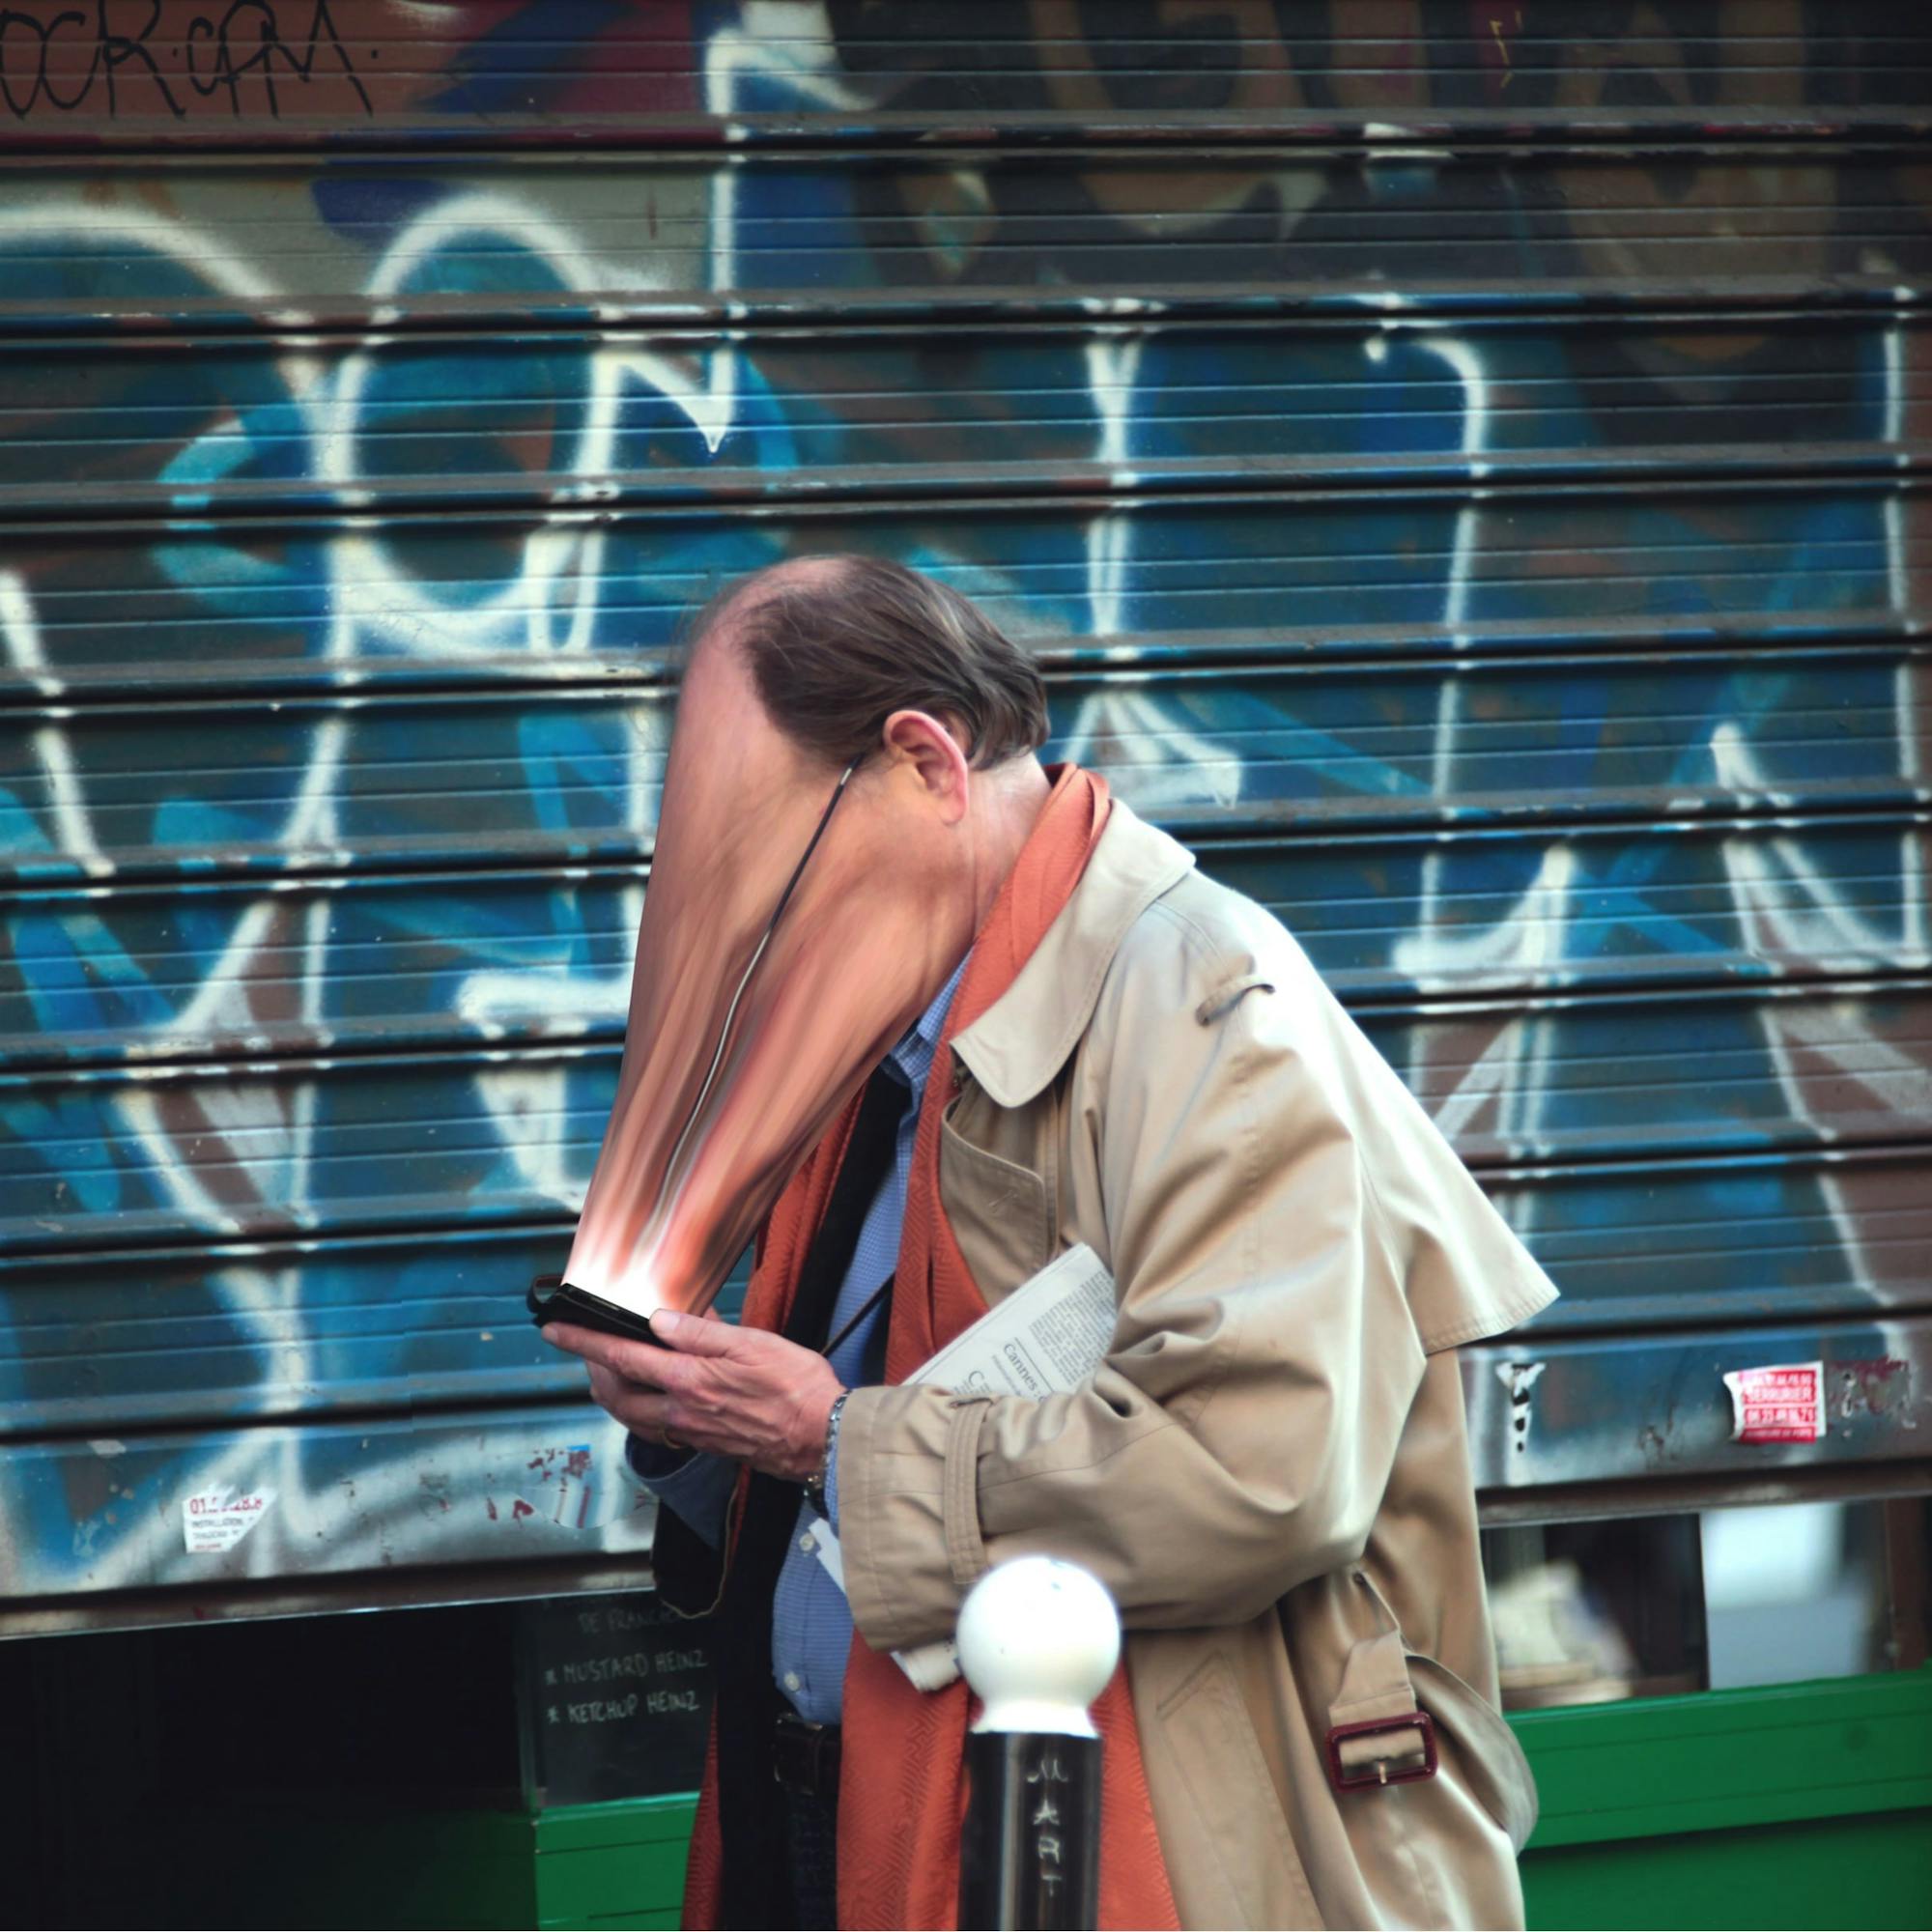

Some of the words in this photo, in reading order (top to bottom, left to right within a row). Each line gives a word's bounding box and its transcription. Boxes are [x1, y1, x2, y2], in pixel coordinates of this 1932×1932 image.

[1003, 1343, 1038, 1393] Cannes
[563, 1652, 648, 1685] MUSTARD
[655, 1649, 708, 1673] HEINZ
[567, 1692, 639, 1724] KETCHUP
[646, 1690, 701, 1715] HEINZ
